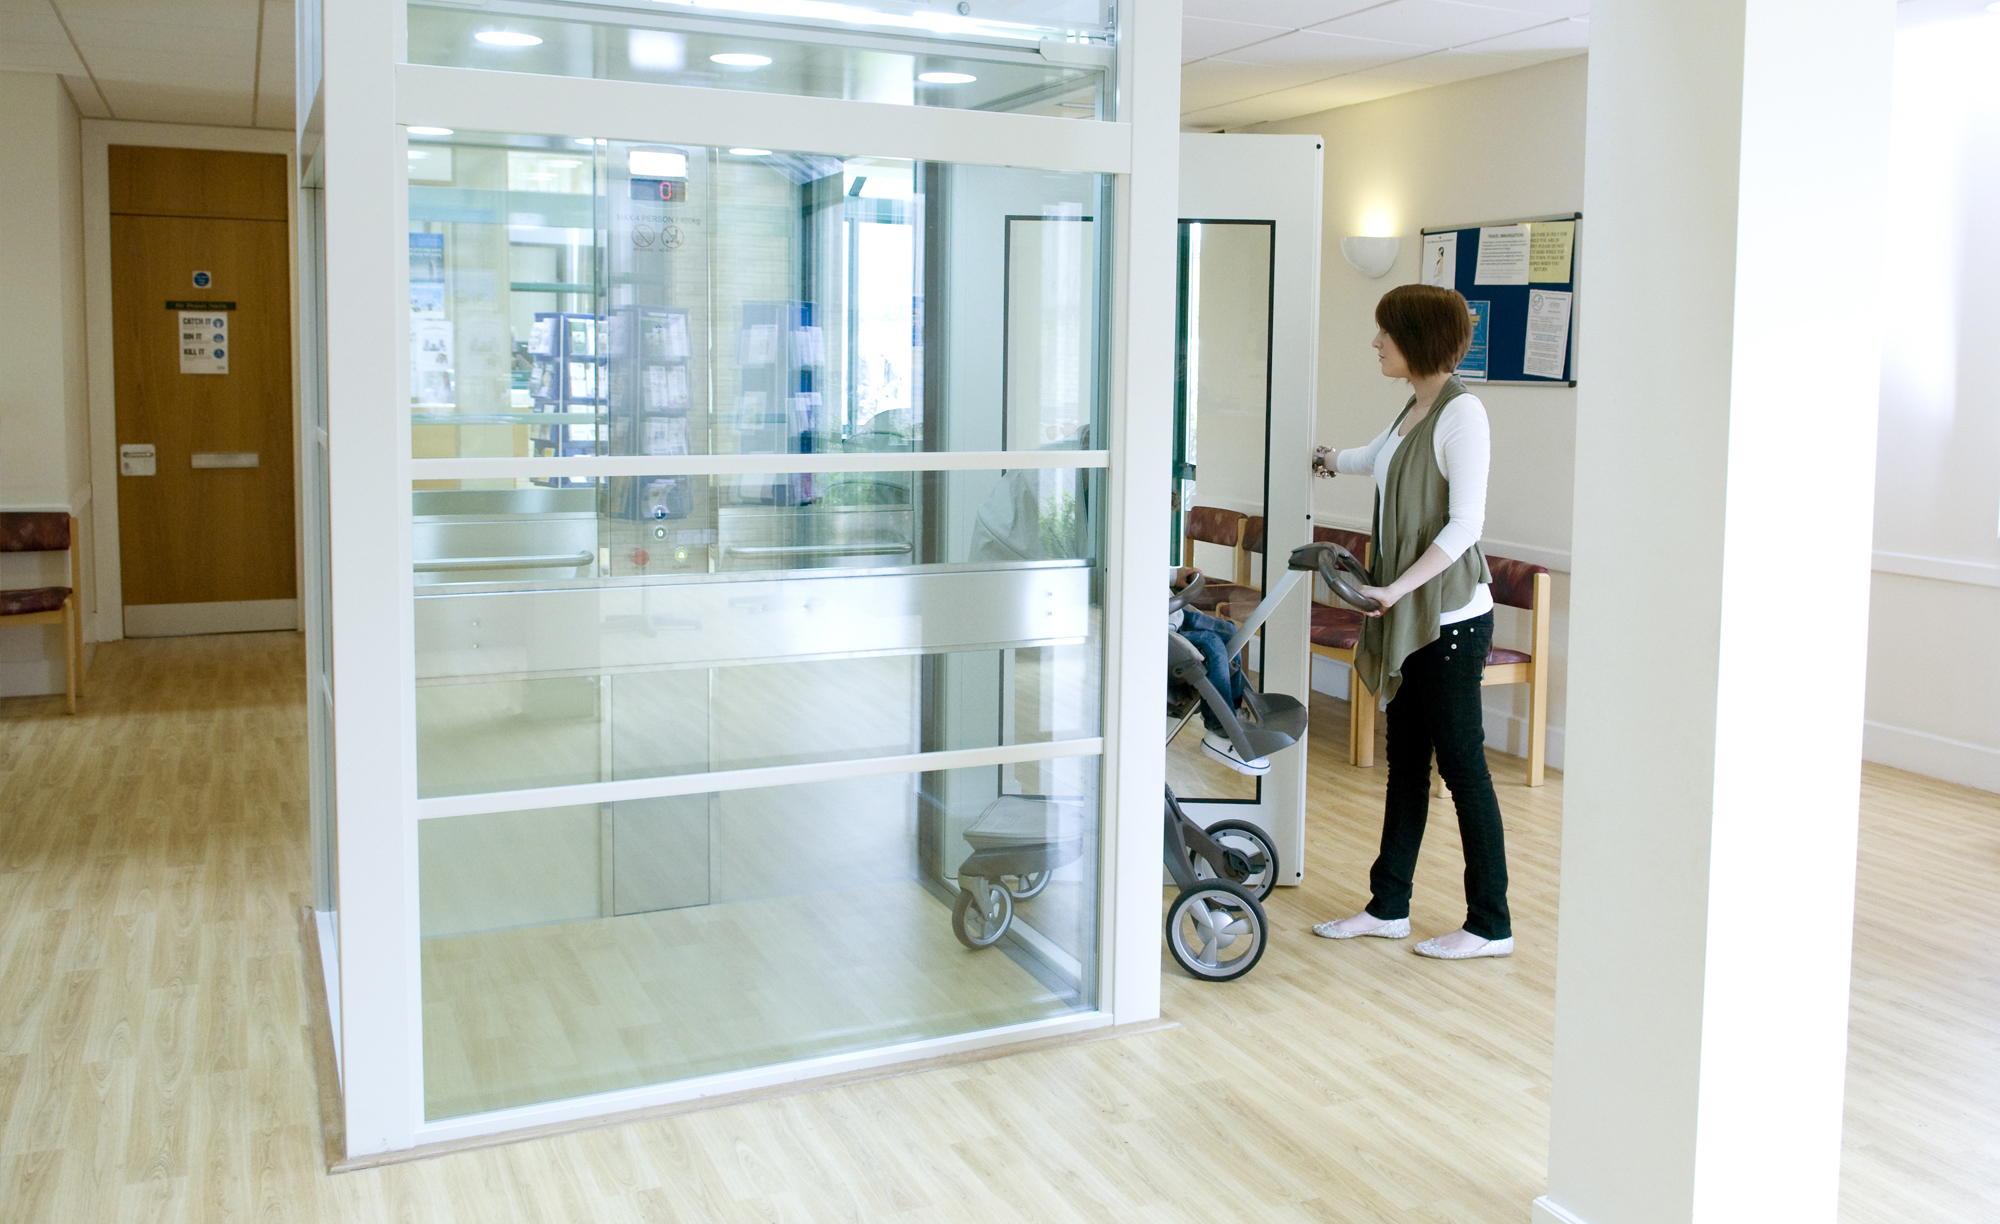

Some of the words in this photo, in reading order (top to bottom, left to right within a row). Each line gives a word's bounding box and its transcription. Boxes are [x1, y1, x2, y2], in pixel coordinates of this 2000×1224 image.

[660, 181, 672, 200] 0
[616, 214, 634, 222] MAX
[641, 215, 674, 223] PERSON
[679, 217, 701, 226] 400kg
[183, 317, 204, 325] CATCH
[205, 317, 211, 325] IT
